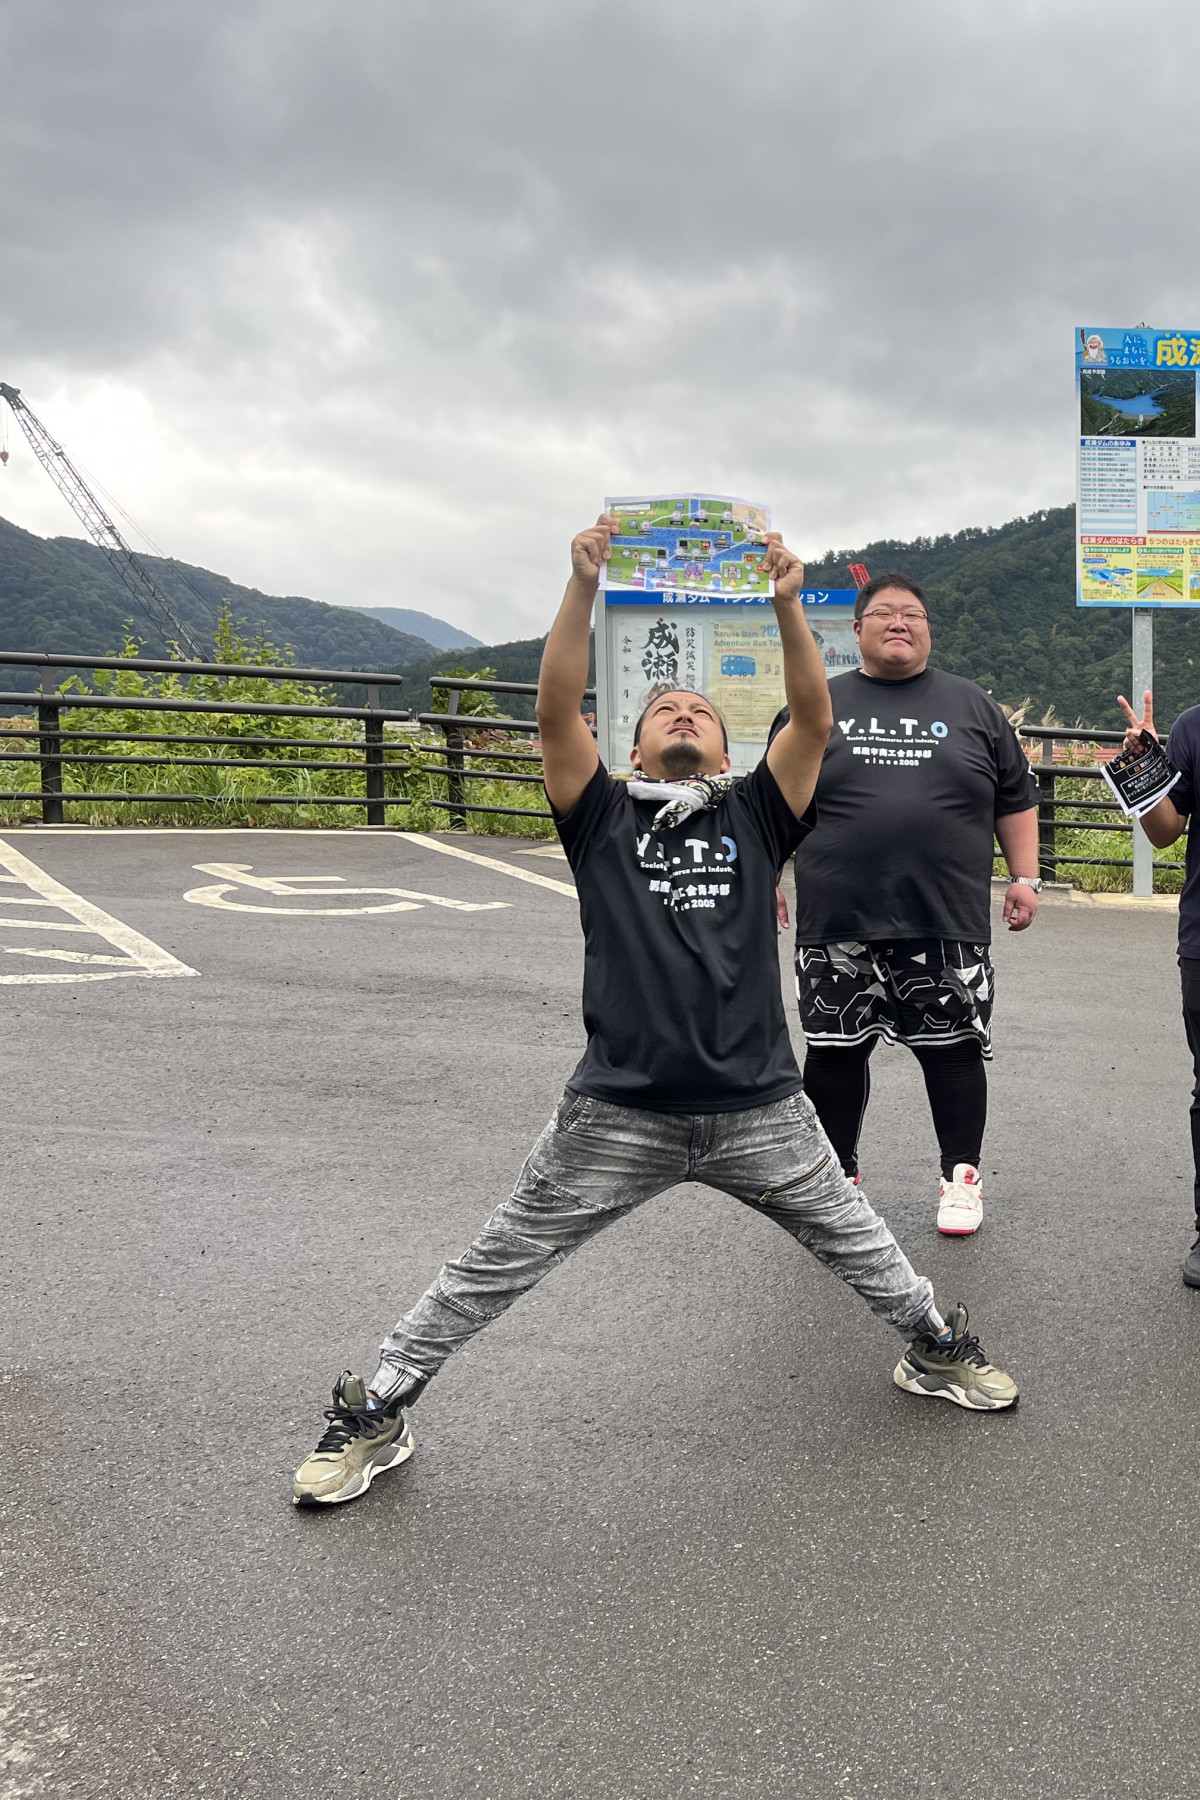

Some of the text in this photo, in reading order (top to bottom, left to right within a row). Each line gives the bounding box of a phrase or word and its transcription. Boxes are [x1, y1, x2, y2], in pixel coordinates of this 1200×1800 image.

[1124, 335, 1146, 345] 人に、
[1123, 346, 1147, 355] まちに
[1109, 356, 1151, 366] うるおいを。
[1082, 536, 1144, 545] 成瀬ダムのはたらき
[760, 624, 780, 638] 202
[875, 736, 903, 744] Commerce
[692, 865, 706, 873] and
